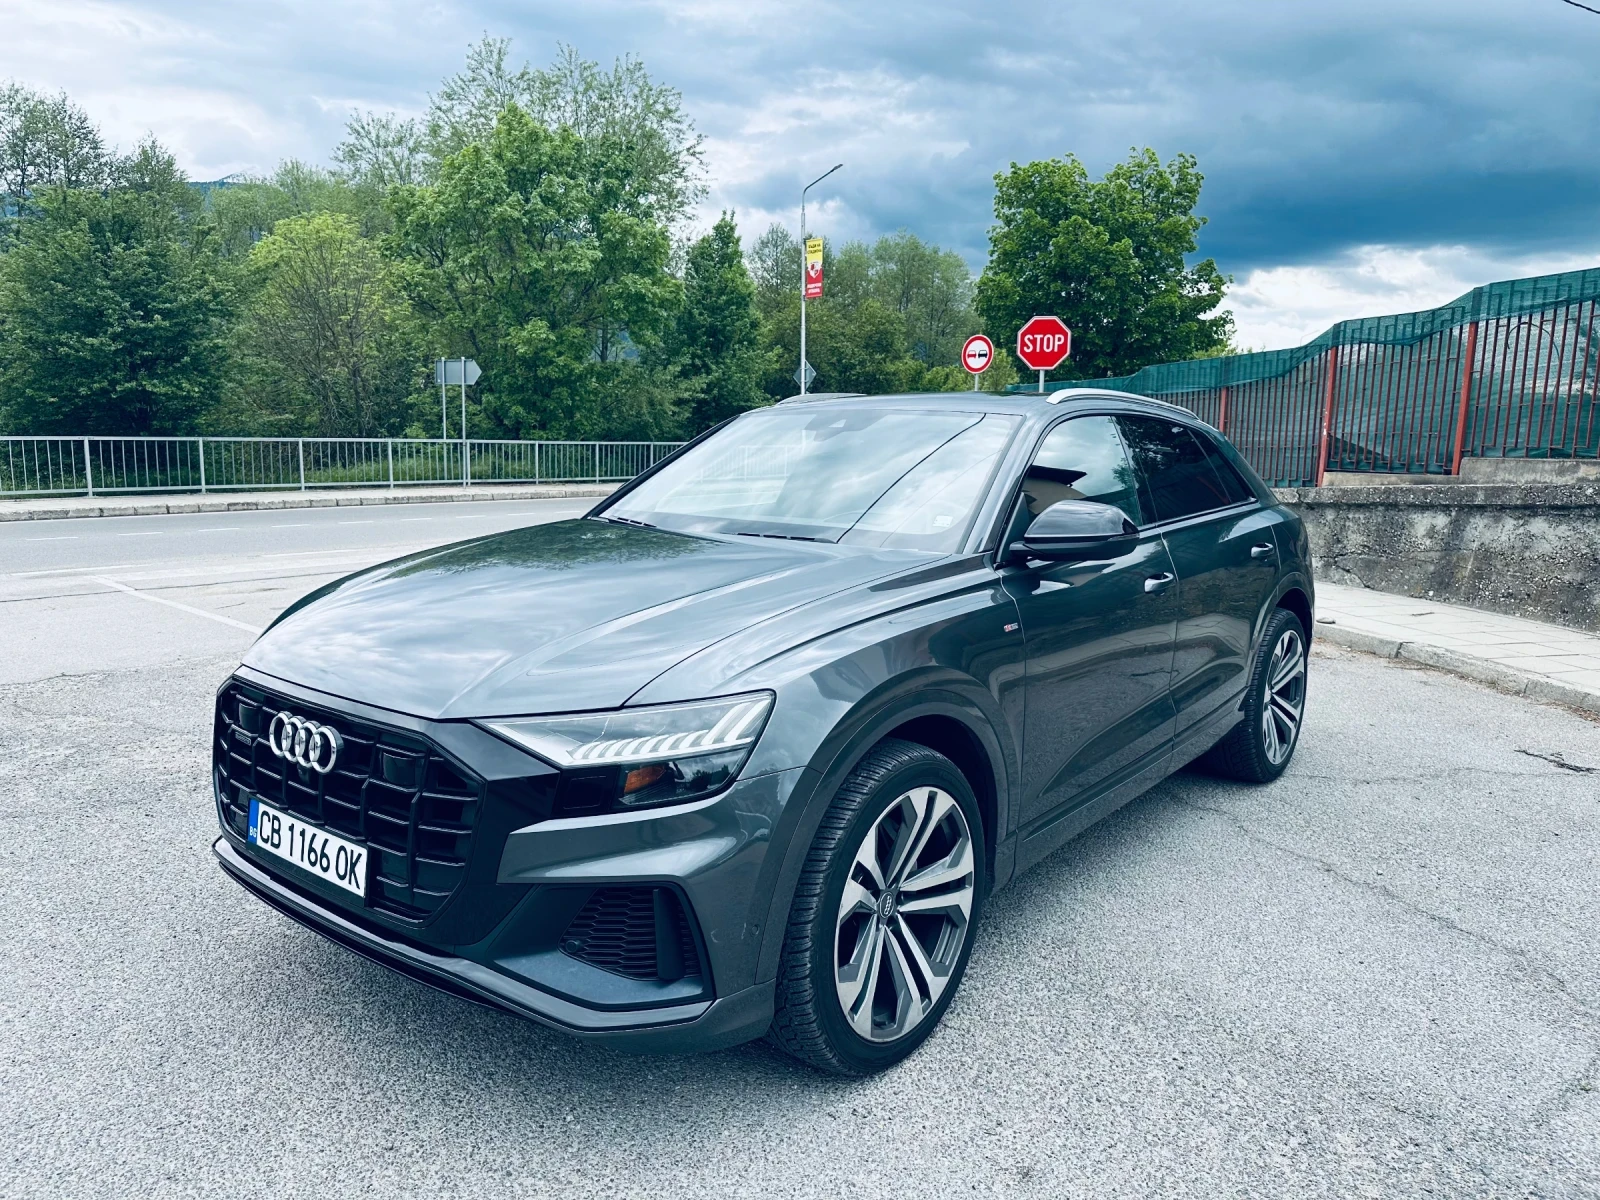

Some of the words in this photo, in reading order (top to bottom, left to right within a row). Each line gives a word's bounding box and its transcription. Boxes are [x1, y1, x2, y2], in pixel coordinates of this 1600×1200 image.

[1023, 334, 1065, 352] STOP
[249, 826, 257, 837] BG
[260, 810, 281, 849] CB
[288, 823, 330, 872] 1166
[335, 845, 362, 890] OK
